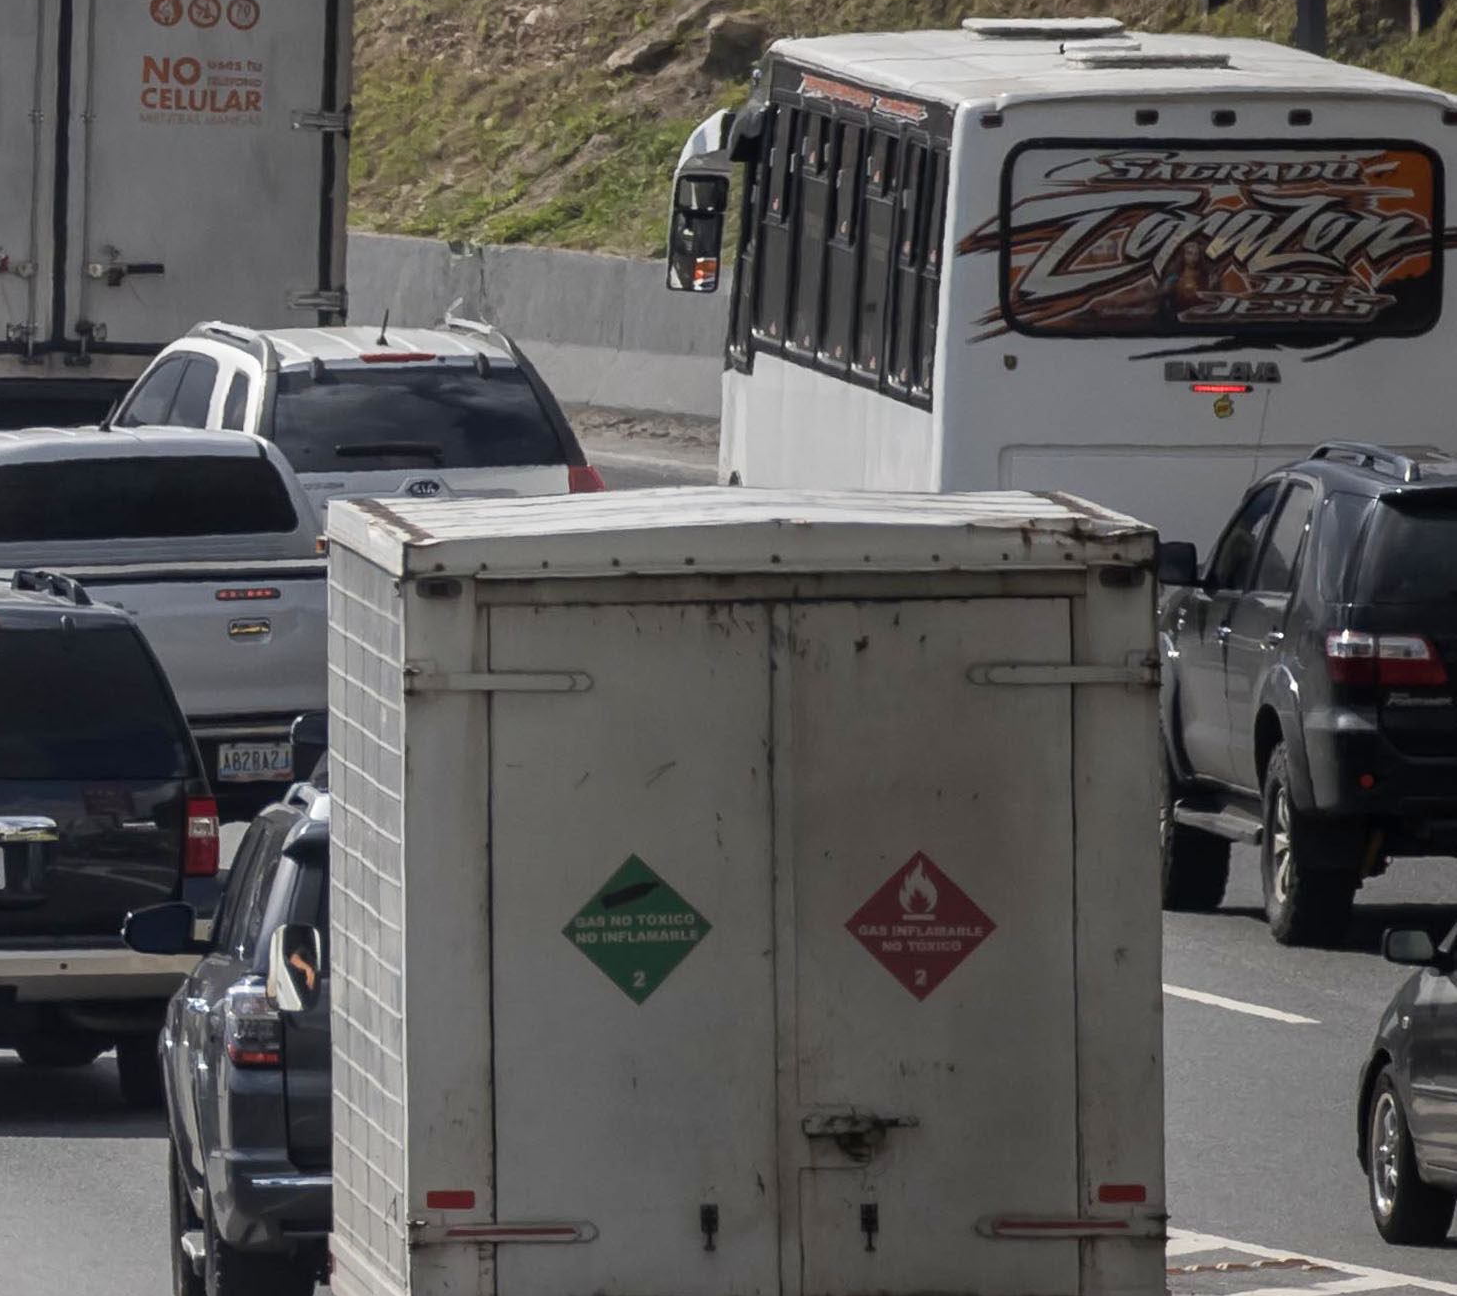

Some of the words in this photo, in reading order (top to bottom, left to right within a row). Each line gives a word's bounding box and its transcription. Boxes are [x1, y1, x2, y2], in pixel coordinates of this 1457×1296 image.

[141, 55, 202, 86] NO
[208, 60, 243, 72] uses
[246, 59, 263, 72] tu
[140, 87, 262, 113] CELULAR
[1106, 157, 1362, 186] SAGRADO
[1262, 275, 1339, 295] DE
[1197, 294, 1382, 320] JESUS
[1164, 360, 1281, 384] ENCAVA
[574, 915, 606, 929] GAS
[609, 914, 633, 928] NO
[857, 924, 887, 937] GAS
[892, 924, 984, 938] INFLAMABLE
[575, 931, 600, 945] NO
[881, 938, 904, 952] NO
[632, 971, 646, 988] 2
[913, 969, 926, 987] 2
